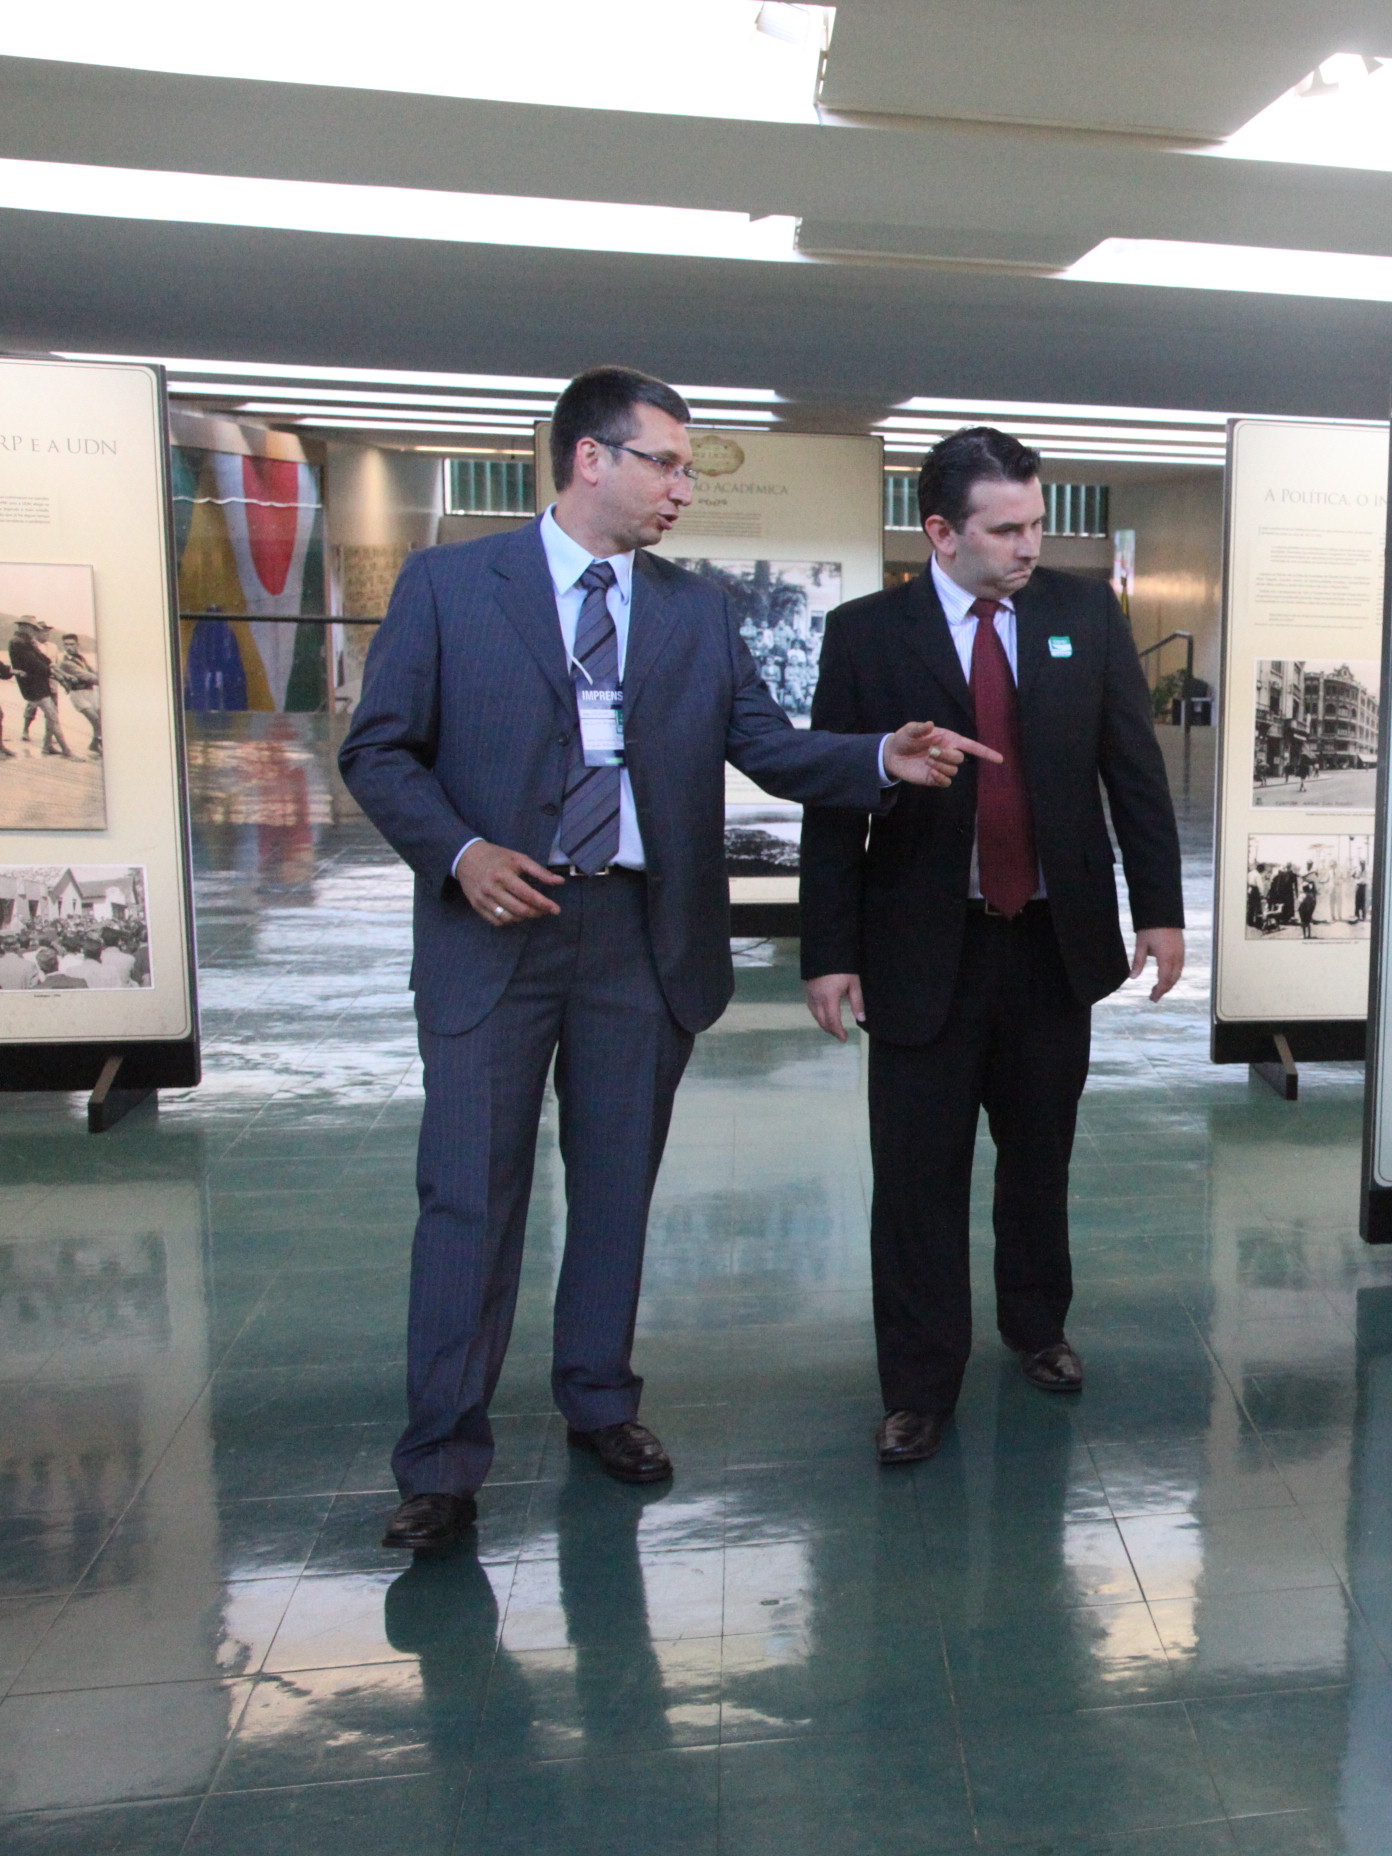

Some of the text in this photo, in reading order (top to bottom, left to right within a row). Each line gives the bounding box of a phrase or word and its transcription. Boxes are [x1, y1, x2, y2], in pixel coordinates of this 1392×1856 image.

[32, 438, 41, 453] E
[48, 439, 60, 453] A
[67, 437, 117, 456] UDN
[1264, 488, 1275, 503] A
[1356, 494, 1369, 507] O
